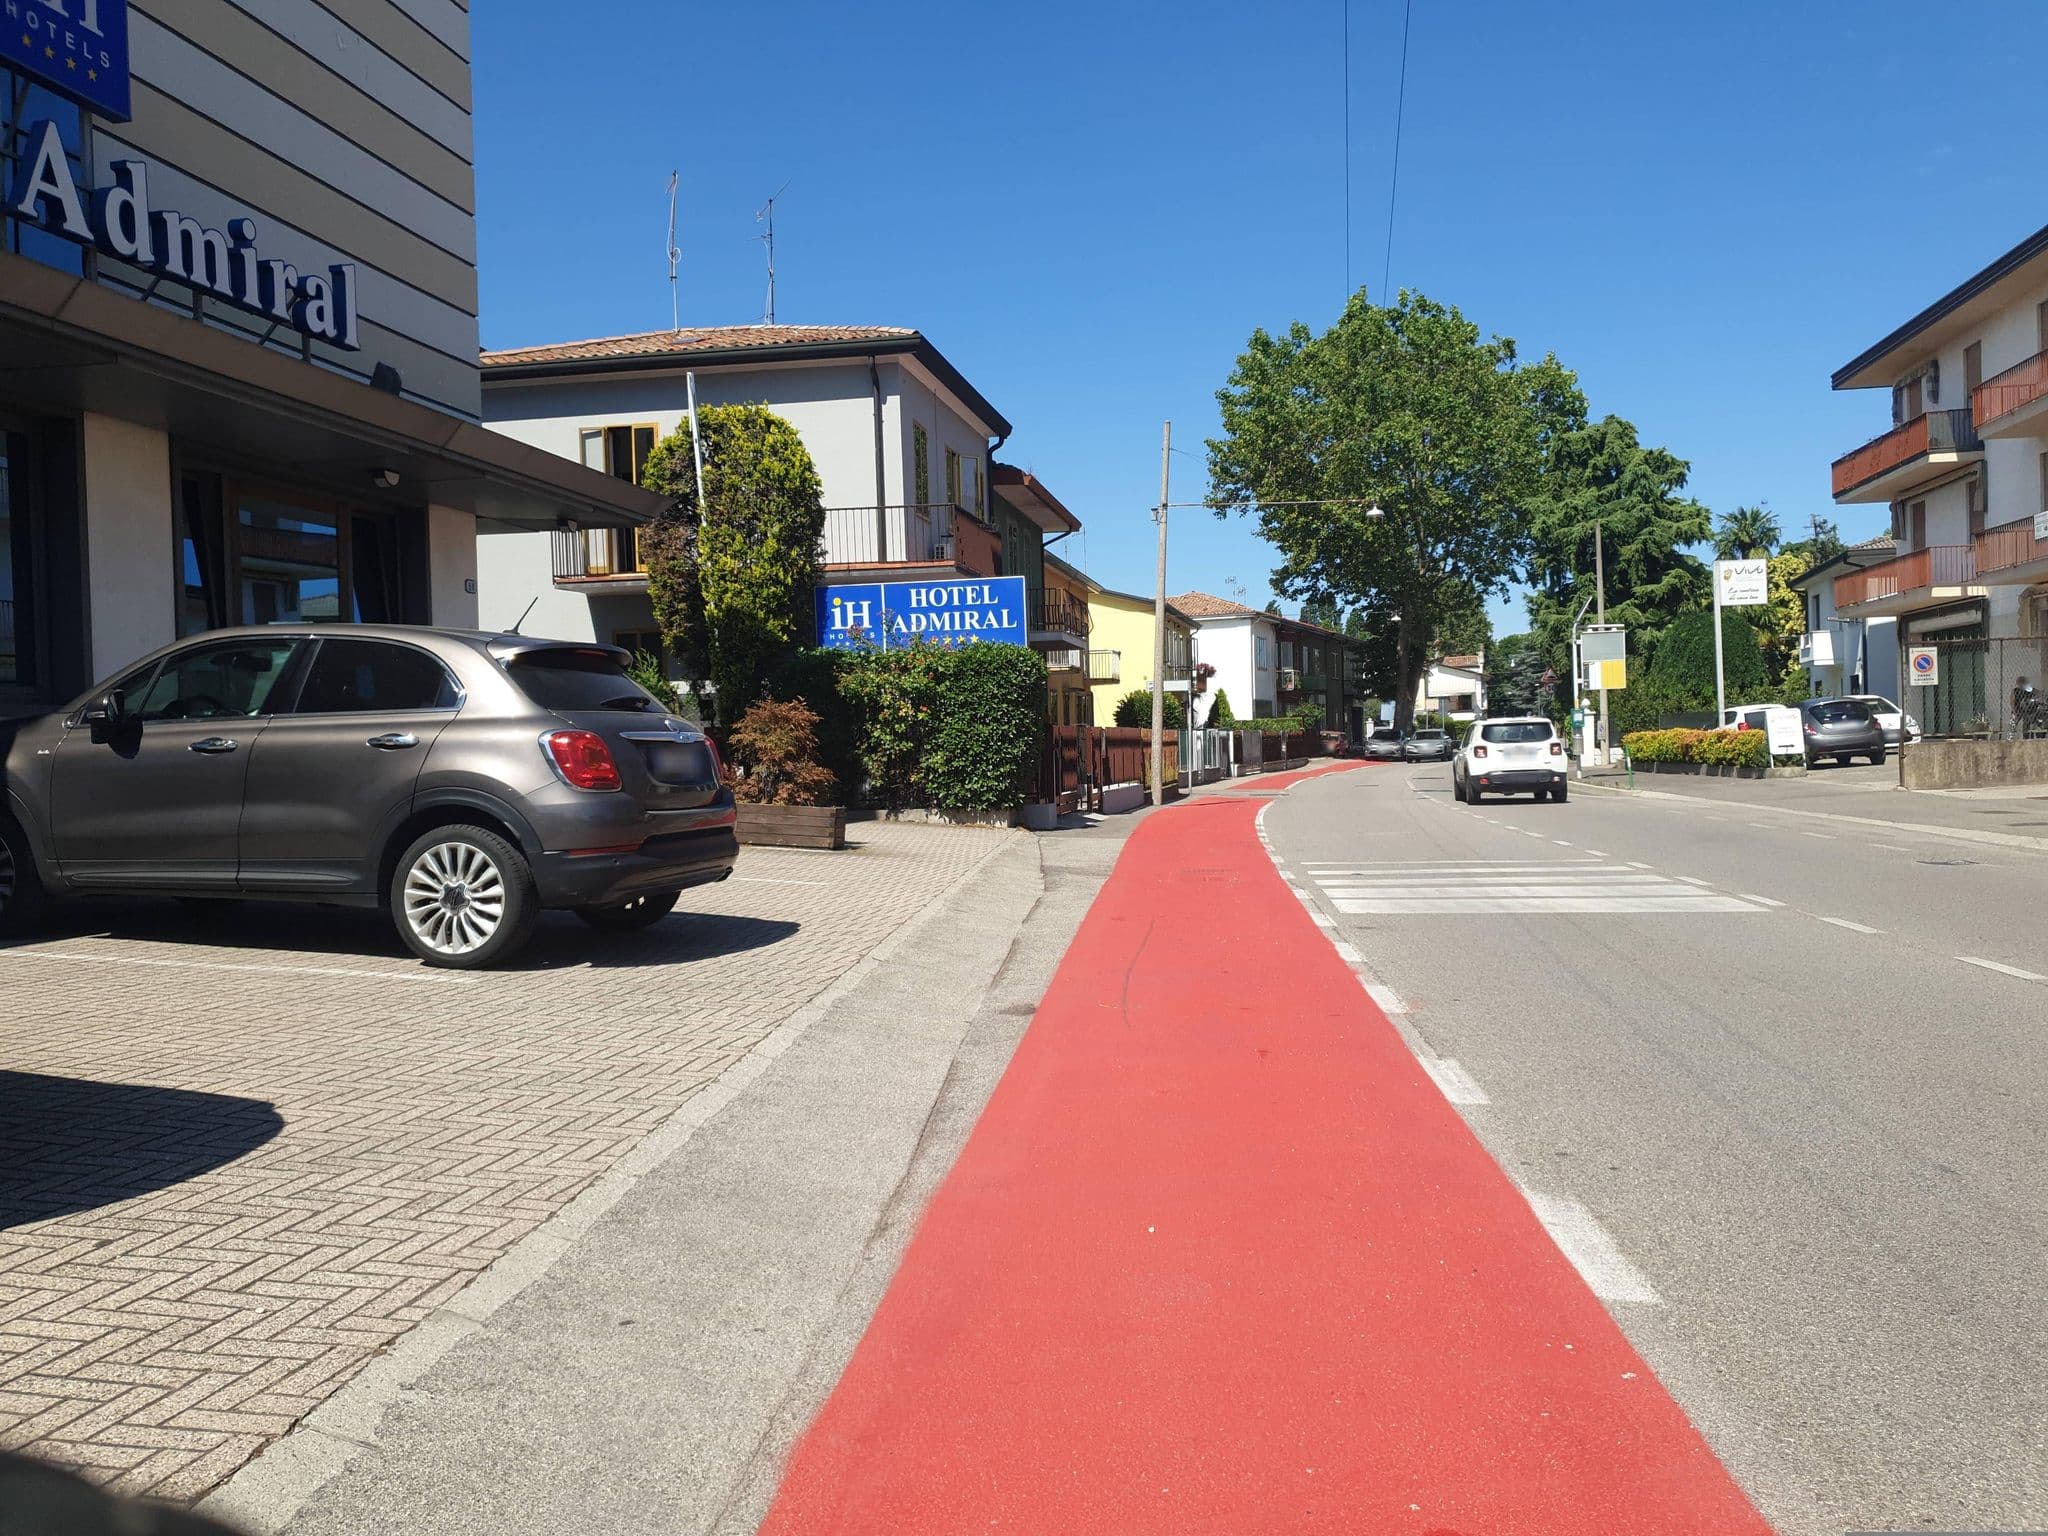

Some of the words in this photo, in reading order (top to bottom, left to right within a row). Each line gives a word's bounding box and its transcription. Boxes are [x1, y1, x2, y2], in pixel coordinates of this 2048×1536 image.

[5, 0, 110, 68] HOTELS
[16, 119, 361, 351] Admiral
[909, 585, 999, 608] HOTEL
[892, 608, 1018, 633] ADMIRAL
